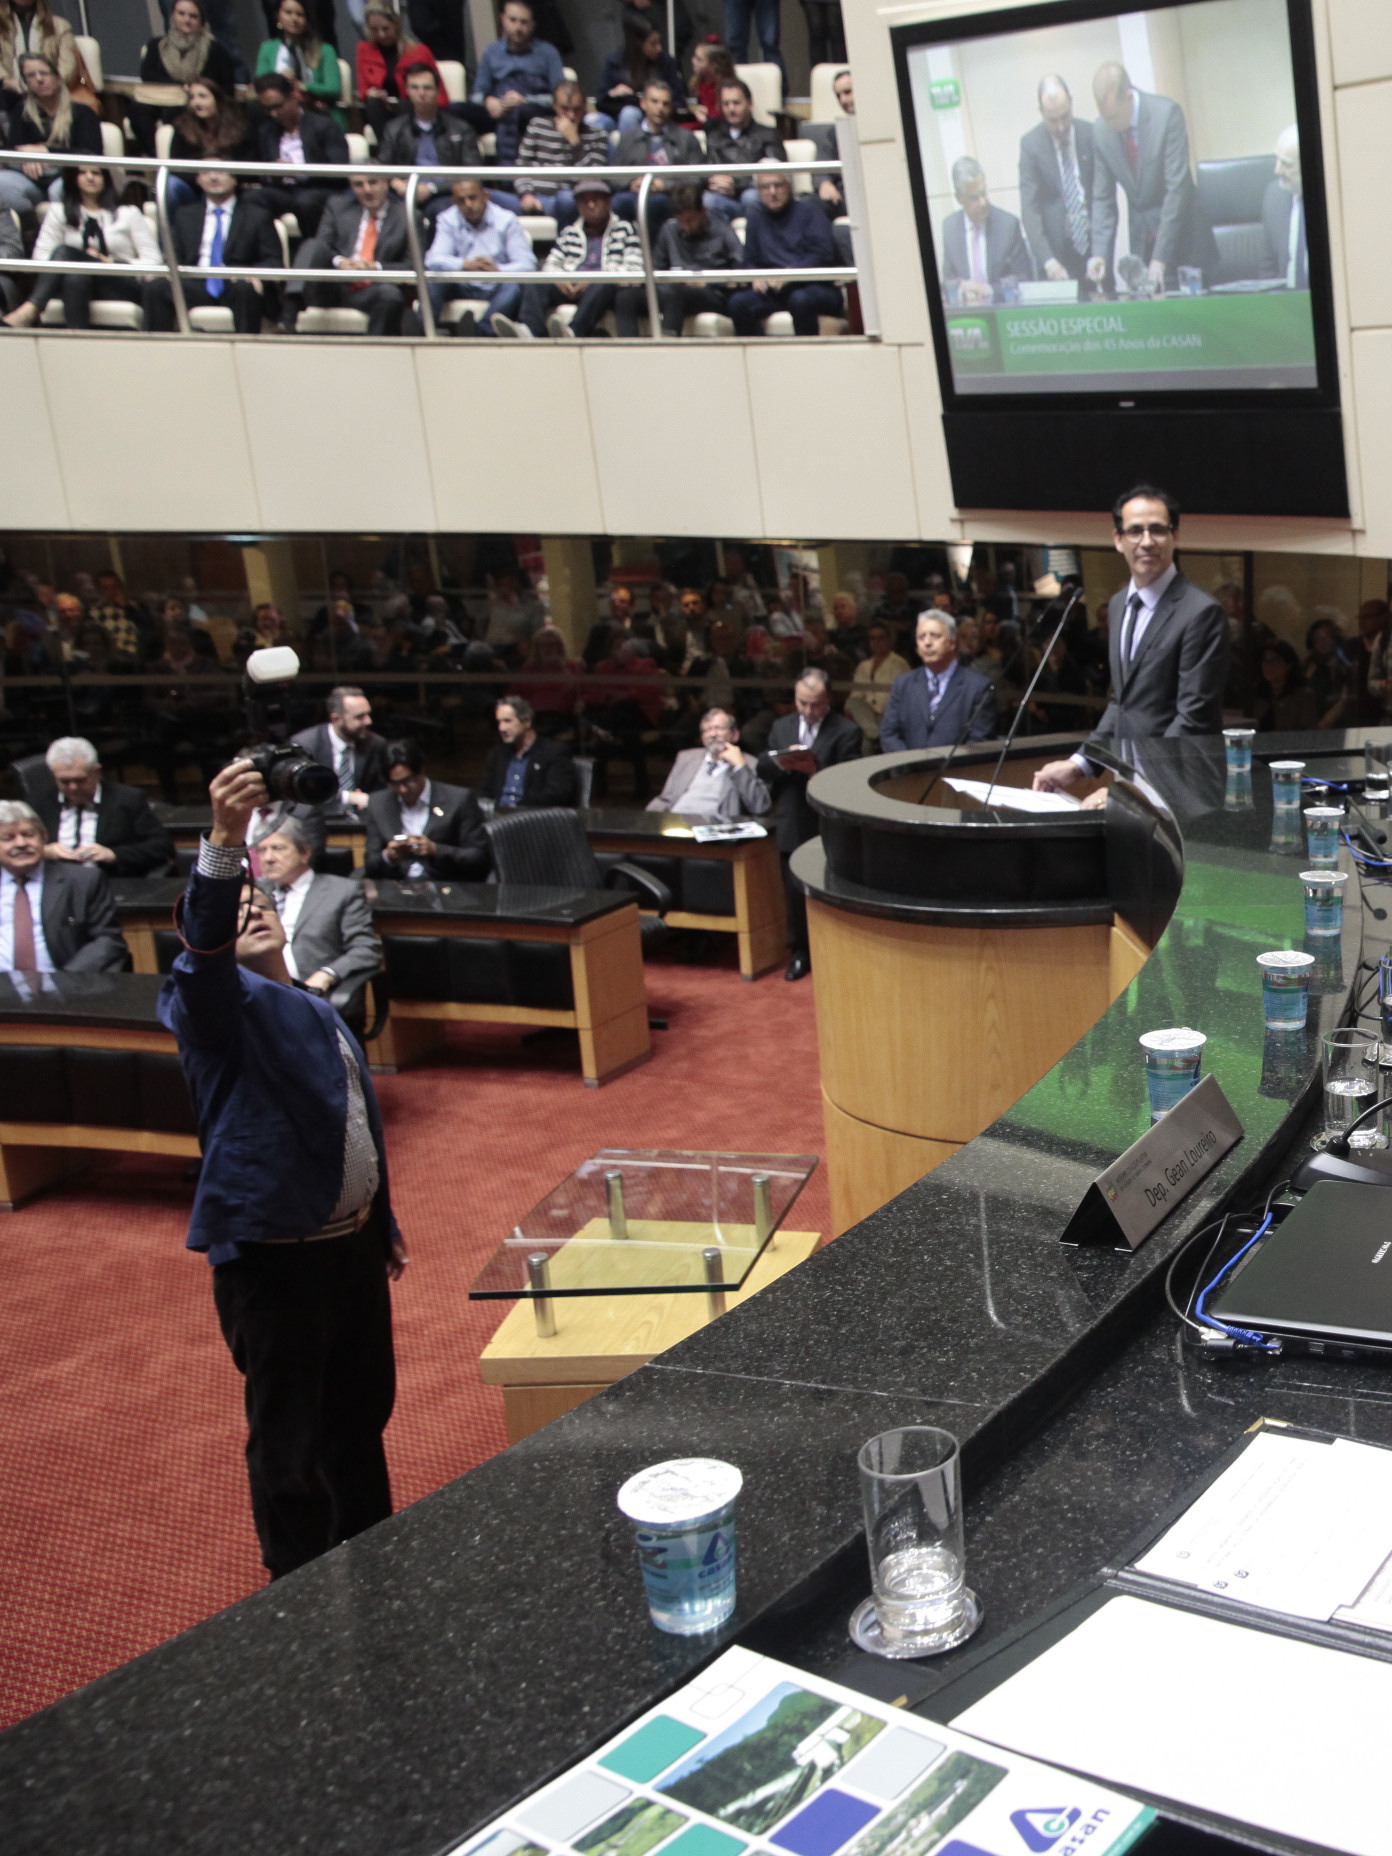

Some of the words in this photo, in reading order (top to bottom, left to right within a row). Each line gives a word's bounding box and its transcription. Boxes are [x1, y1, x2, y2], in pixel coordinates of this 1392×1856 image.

[1061, 316, 1126, 335] ESPECIAL
[1144, 1182, 1170, 1208] Dep.
[1164, 1159, 1190, 1187] Gean
[1183, 1130, 1217, 1167] Loureiro
